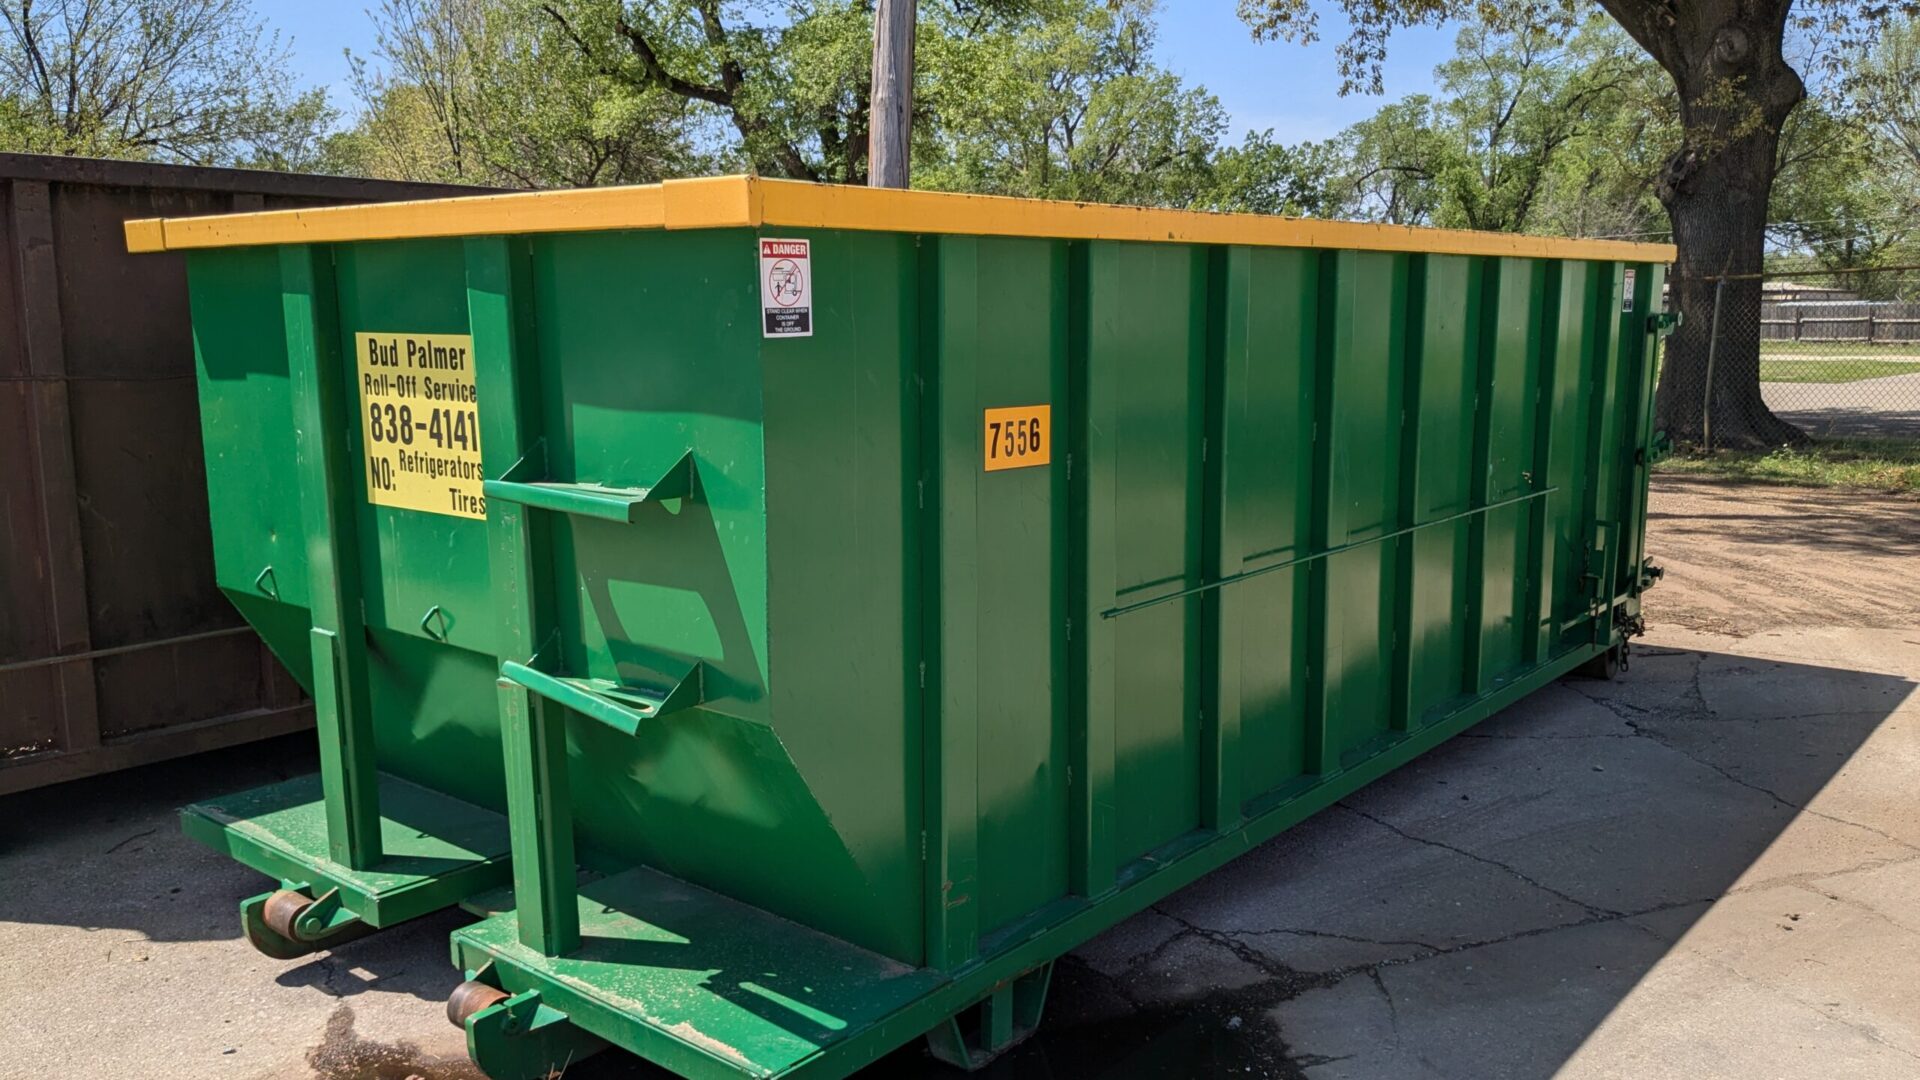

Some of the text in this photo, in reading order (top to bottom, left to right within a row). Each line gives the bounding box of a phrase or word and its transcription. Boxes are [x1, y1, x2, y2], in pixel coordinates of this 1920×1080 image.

[772, 244, 806, 255] DANGER
[368, 338, 466, 371] Bud Palmer
[364, 373, 477, 403] Roll-Off Service
[370, 402, 478, 452] 838-4141
[989, 417, 1041, 459] 7556
[370, 456, 397, 491] NO:
[399, 449, 484, 481] Refrigerators
[449, 488, 486, 515] Tires
